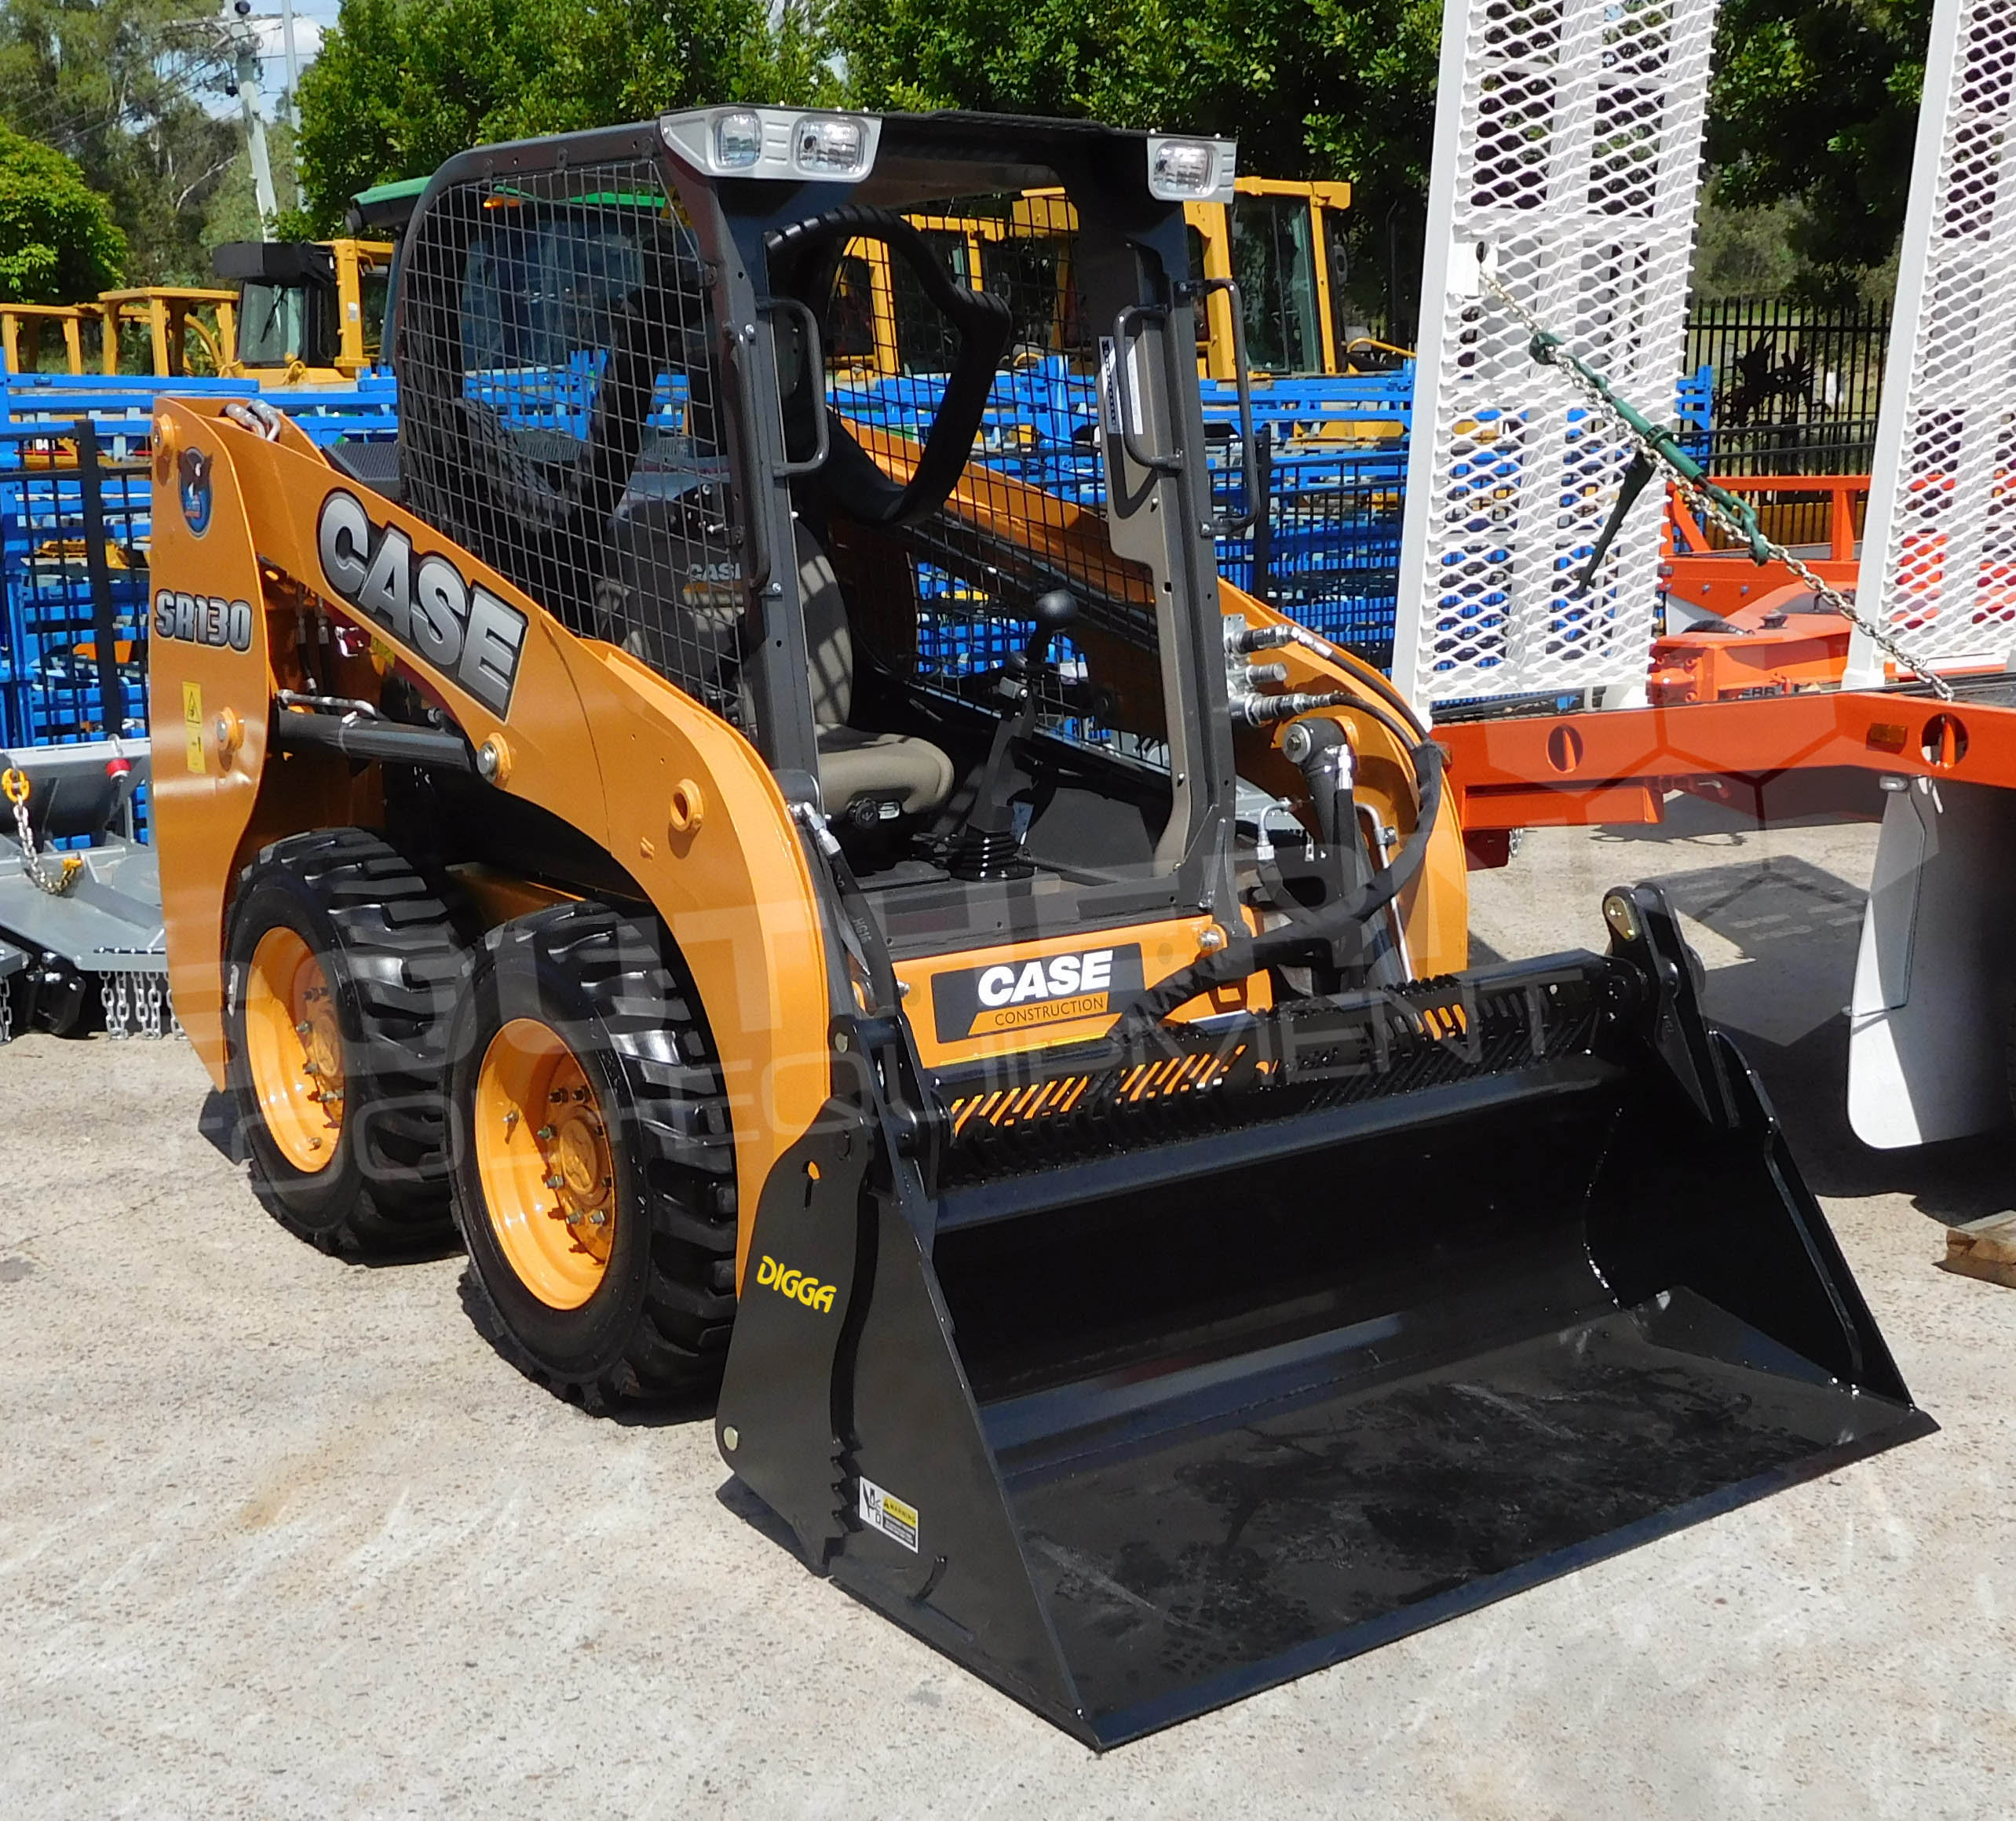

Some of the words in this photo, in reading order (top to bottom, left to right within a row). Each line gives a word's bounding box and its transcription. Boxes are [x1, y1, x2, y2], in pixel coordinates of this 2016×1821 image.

[155, 588, 252, 652] SR130
[317, 487, 528, 724] CASE
[977, 949, 1113, 1006] CASE
[995, 997, 1103, 1026] CONSTRUCTION
[756, 1255, 838, 1313] DIGGA
